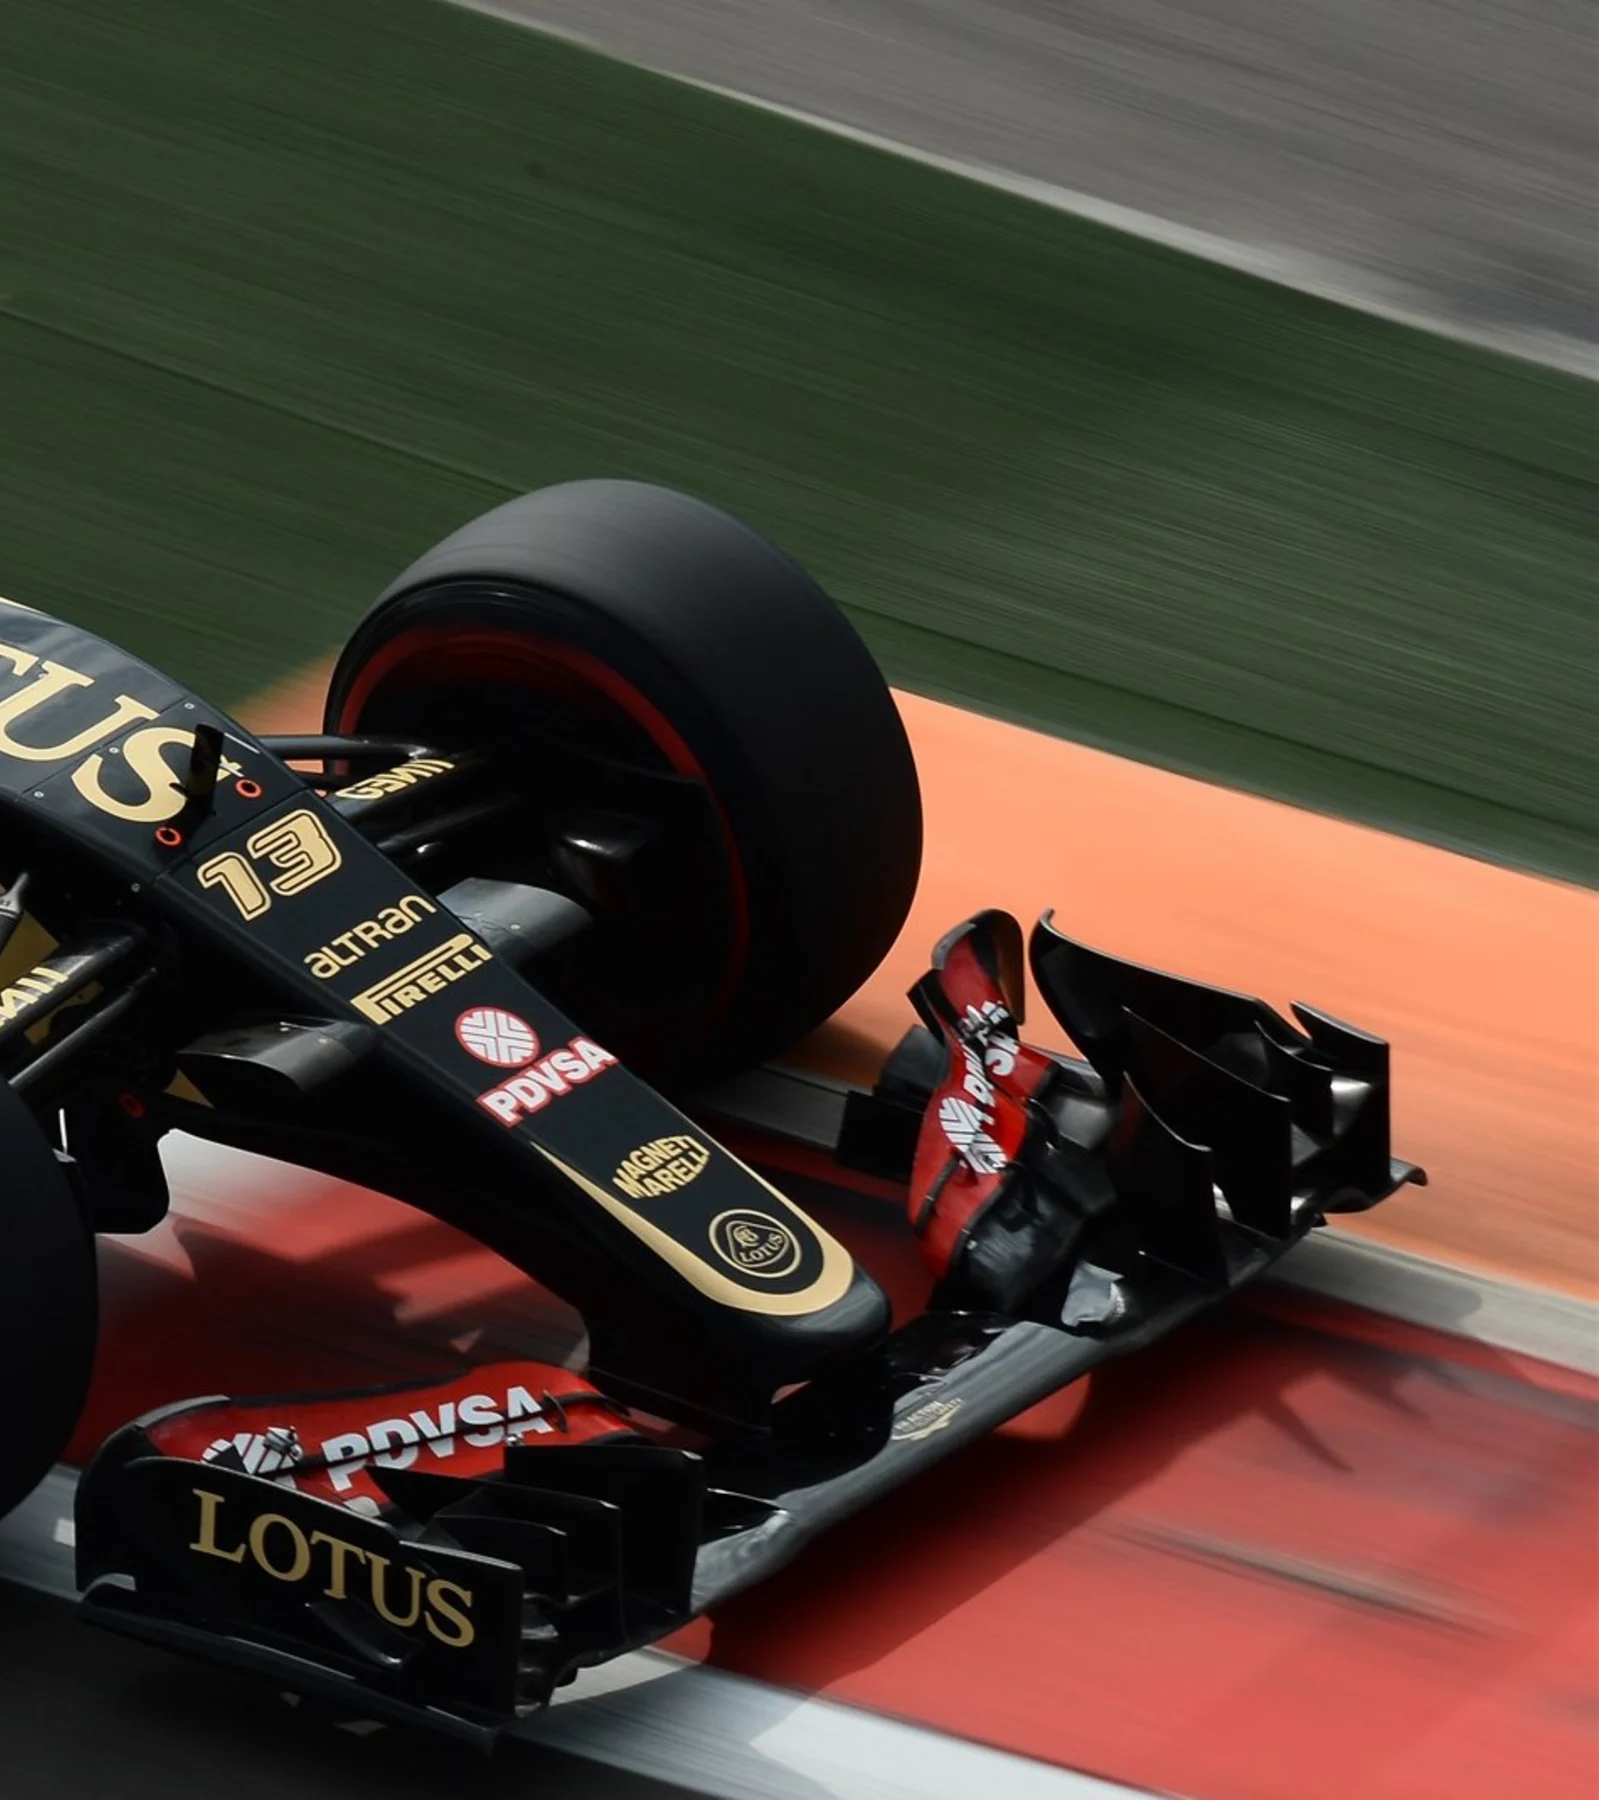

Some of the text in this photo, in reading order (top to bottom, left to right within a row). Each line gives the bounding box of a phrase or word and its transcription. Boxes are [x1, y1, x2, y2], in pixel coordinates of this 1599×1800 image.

[197, 809, 342, 921] 13
[350, 933, 494, 1026] PIRELLI
[478, 1037, 617, 1126] PDVSA
[612, 1135, 709, 1186] MAGNETI
[739, 1233, 783, 1262] LOTUS
[320, 1385, 554, 1492] PDVSA
[189, 1488, 475, 1648] LOTUS
